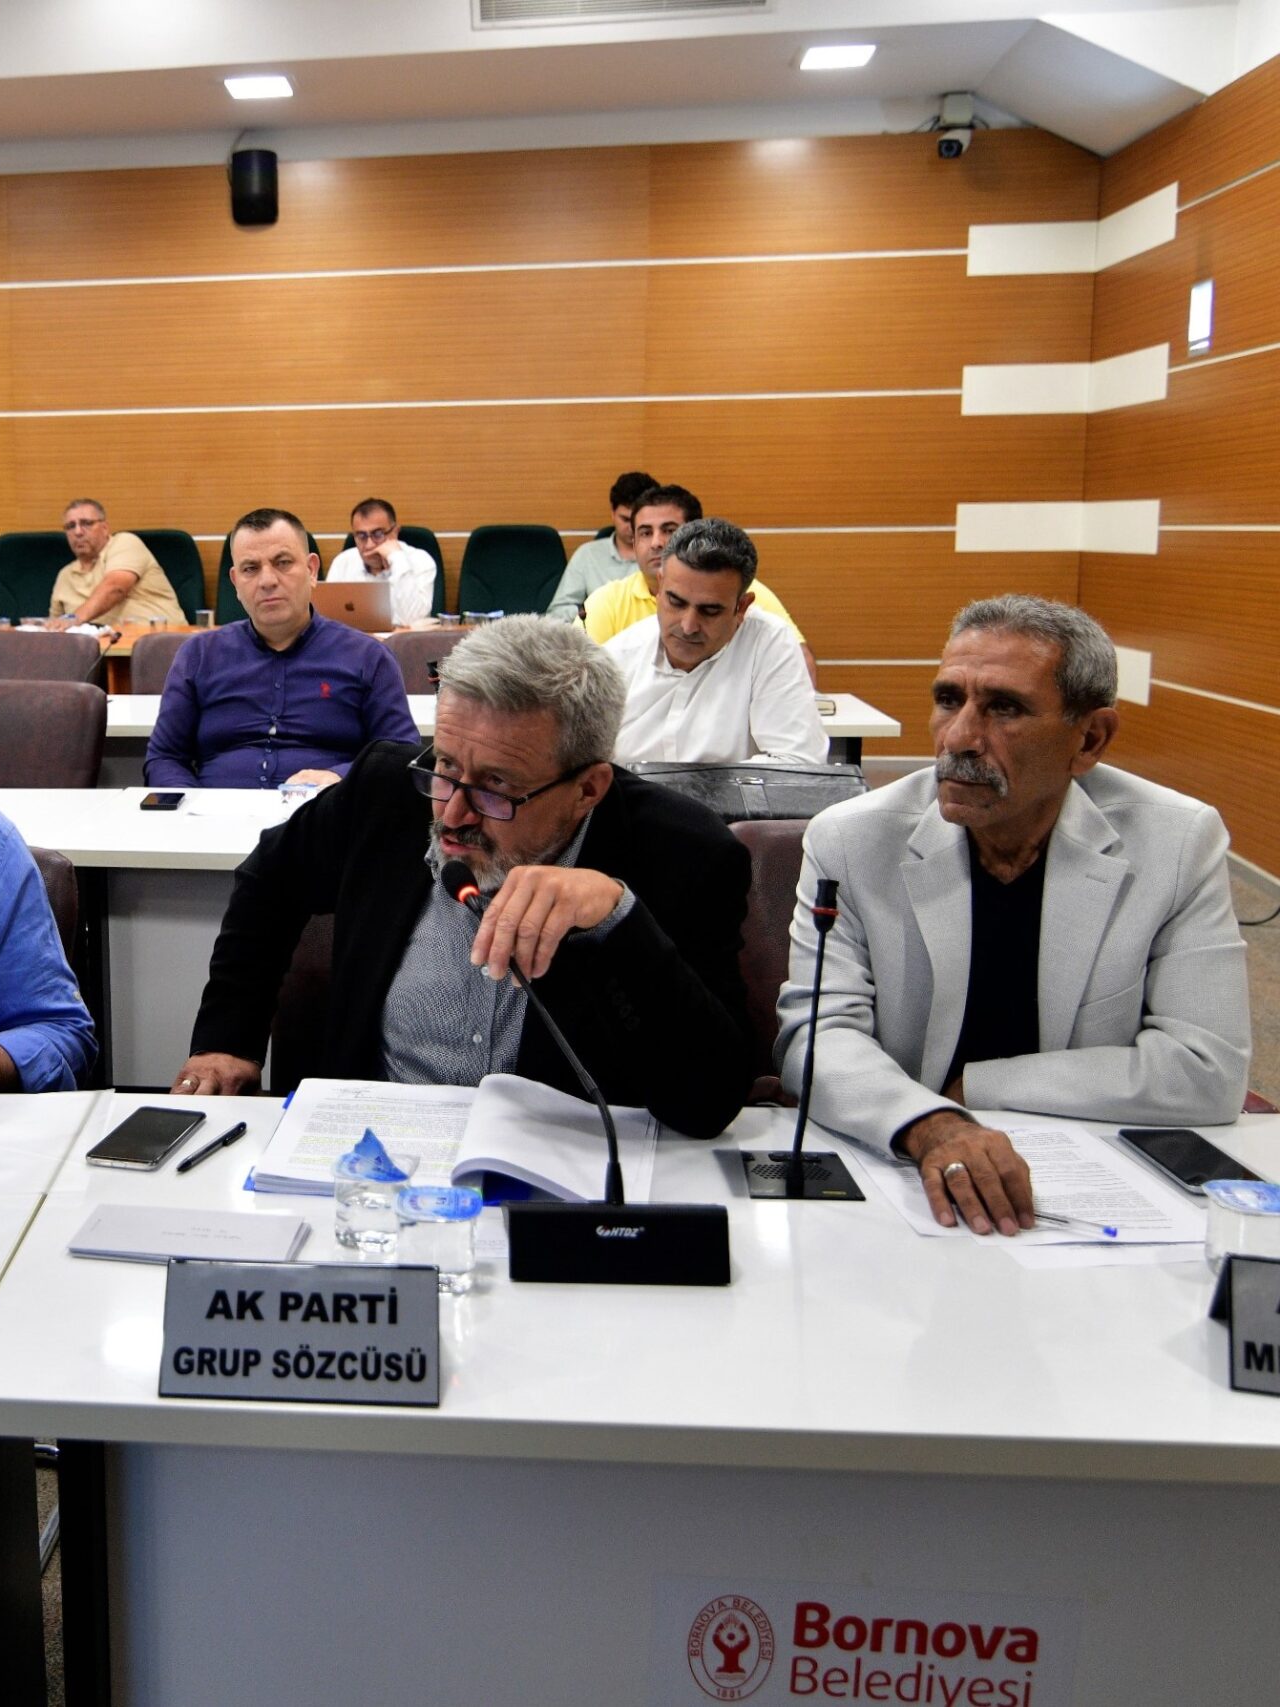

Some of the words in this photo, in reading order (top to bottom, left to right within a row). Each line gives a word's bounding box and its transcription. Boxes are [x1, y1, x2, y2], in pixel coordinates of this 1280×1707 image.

[205, 1289, 265, 1321] AK
[278, 1286, 398, 1325] PARTİ
[172, 1346, 262, 1377] GRUP
[271, 1343, 428, 1383] SÖZCÜSÜ
[690, 1600, 728, 1658] BORNOVA
[793, 1601, 1039, 1663] Bornova
[789, 1655, 1032, 1707] Belediyesi
